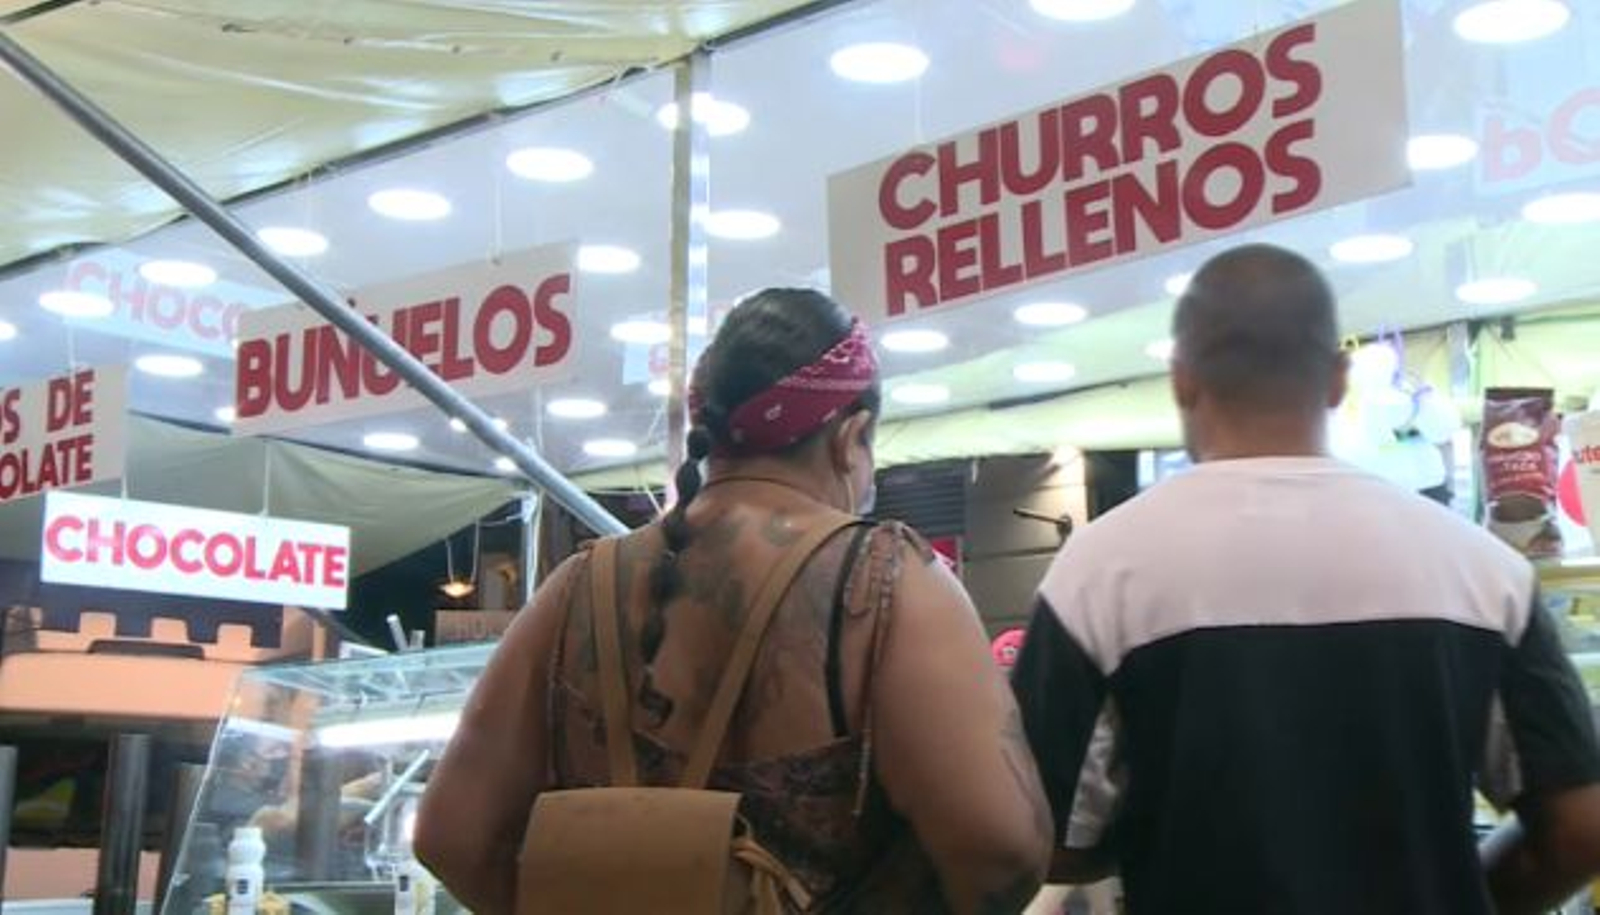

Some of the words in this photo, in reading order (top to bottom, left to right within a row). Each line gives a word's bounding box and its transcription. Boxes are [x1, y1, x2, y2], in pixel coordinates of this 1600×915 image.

[878, 22, 1322, 230] CHURROS
[884, 117, 1322, 317] RELLENOS
[47, 368, 94, 433] DE
[45, 514, 347, 588] CHOCOLATE
